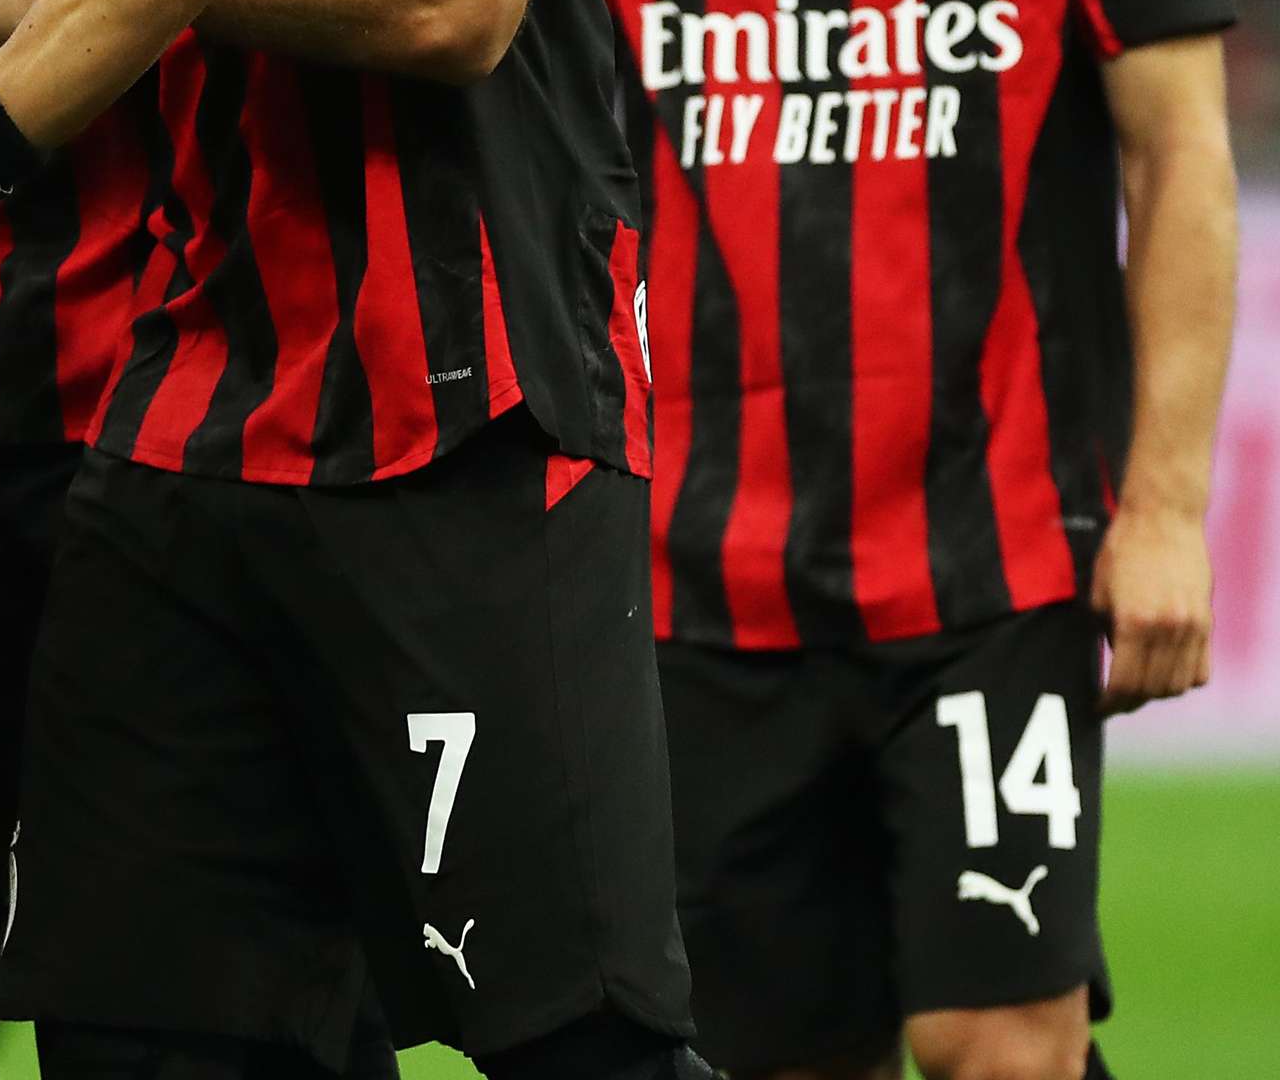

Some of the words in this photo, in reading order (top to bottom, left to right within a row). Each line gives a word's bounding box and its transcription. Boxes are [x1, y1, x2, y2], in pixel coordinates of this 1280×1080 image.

[681, 94, 764, 169] FLY
[773, 86, 961, 165] BETTER
[407, 712, 476, 874] 7
[936, 690, 1081, 850] 14
